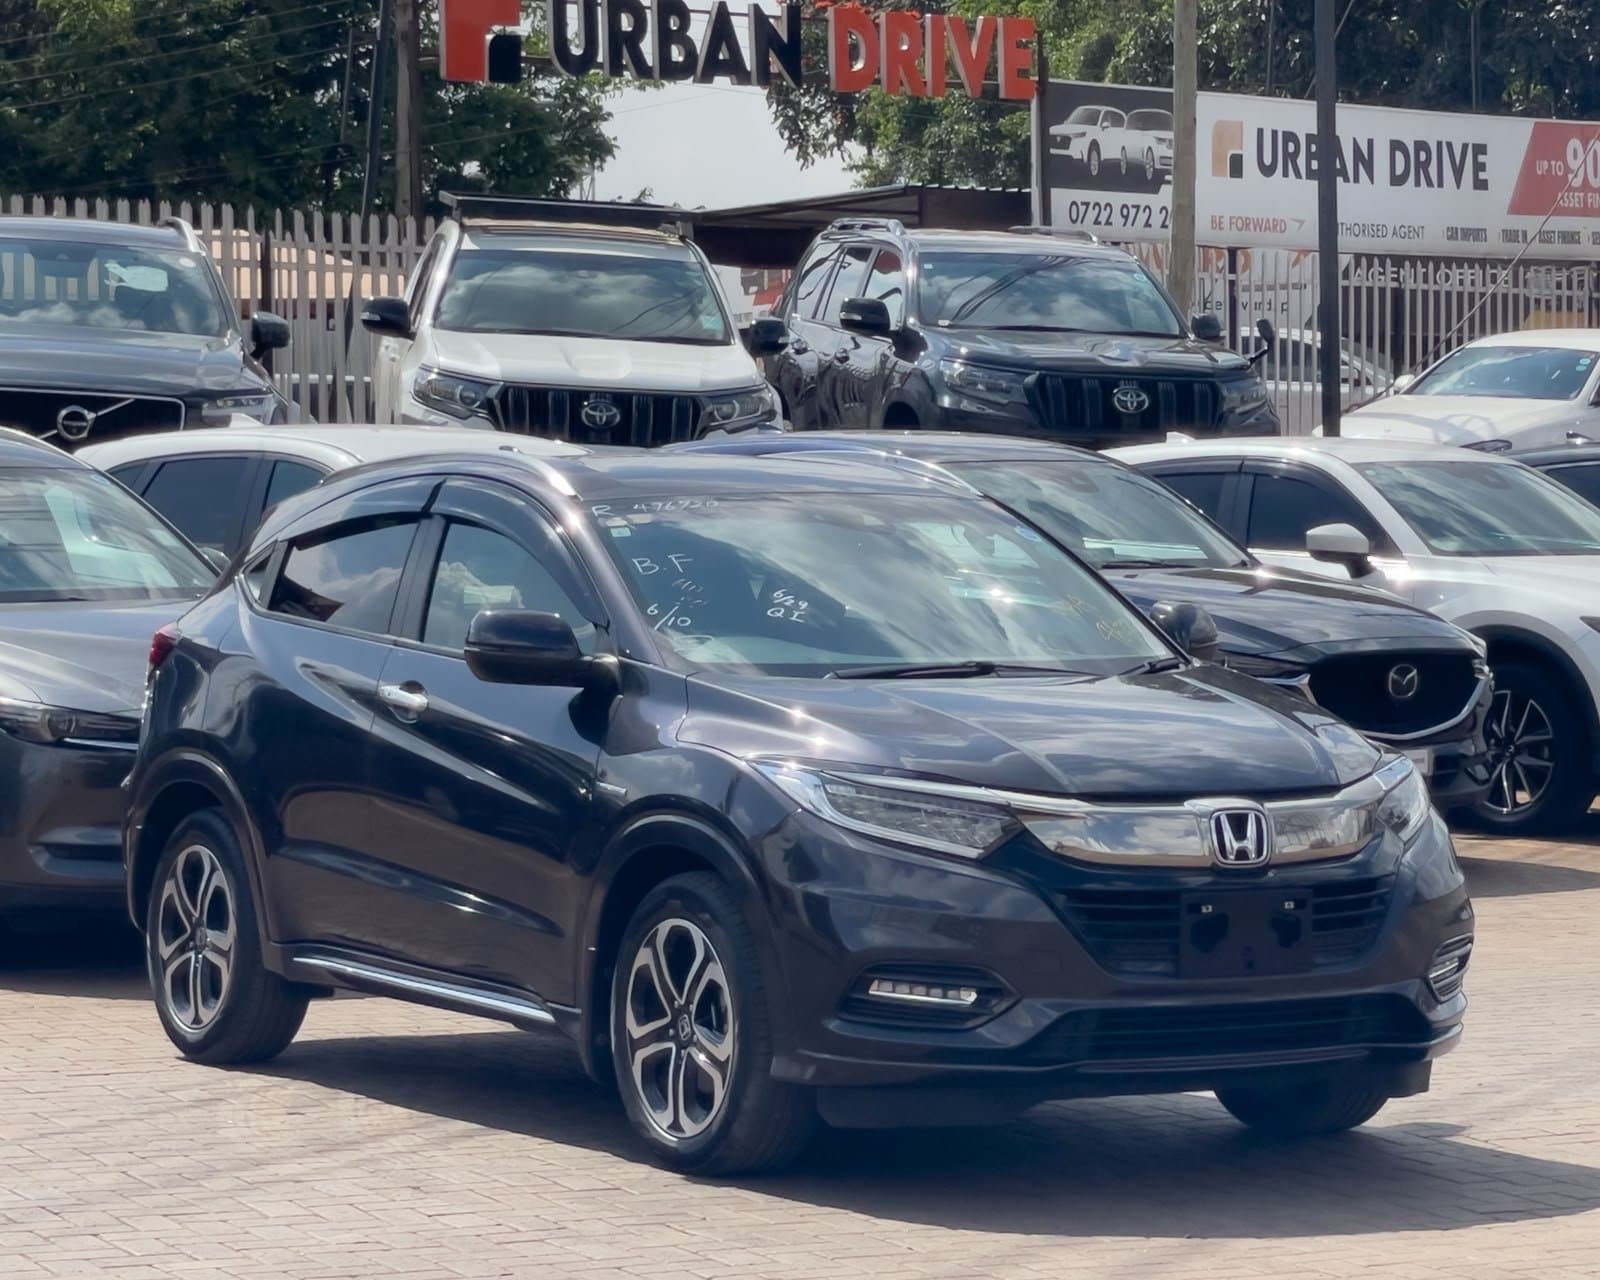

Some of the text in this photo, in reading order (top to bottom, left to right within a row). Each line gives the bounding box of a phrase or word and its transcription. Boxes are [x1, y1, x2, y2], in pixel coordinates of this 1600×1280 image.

[547, 0, 1036, 100] URBAN DRIVE
[1389, 138, 1489, 191] DRIVE
[1536, 160, 1549, 176] UP
[1550, 160, 1564, 177] TO
[1068, 200, 1113, 226] 0722
[1120, 203, 1152, 228] 972
[1211, 215, 1288, 234] BE FORWARD
[1338, 221, 1425, 240] THORISED AGENT
[591, 504, 615, 517] R
[646, 603, 692, 631] 6/10
